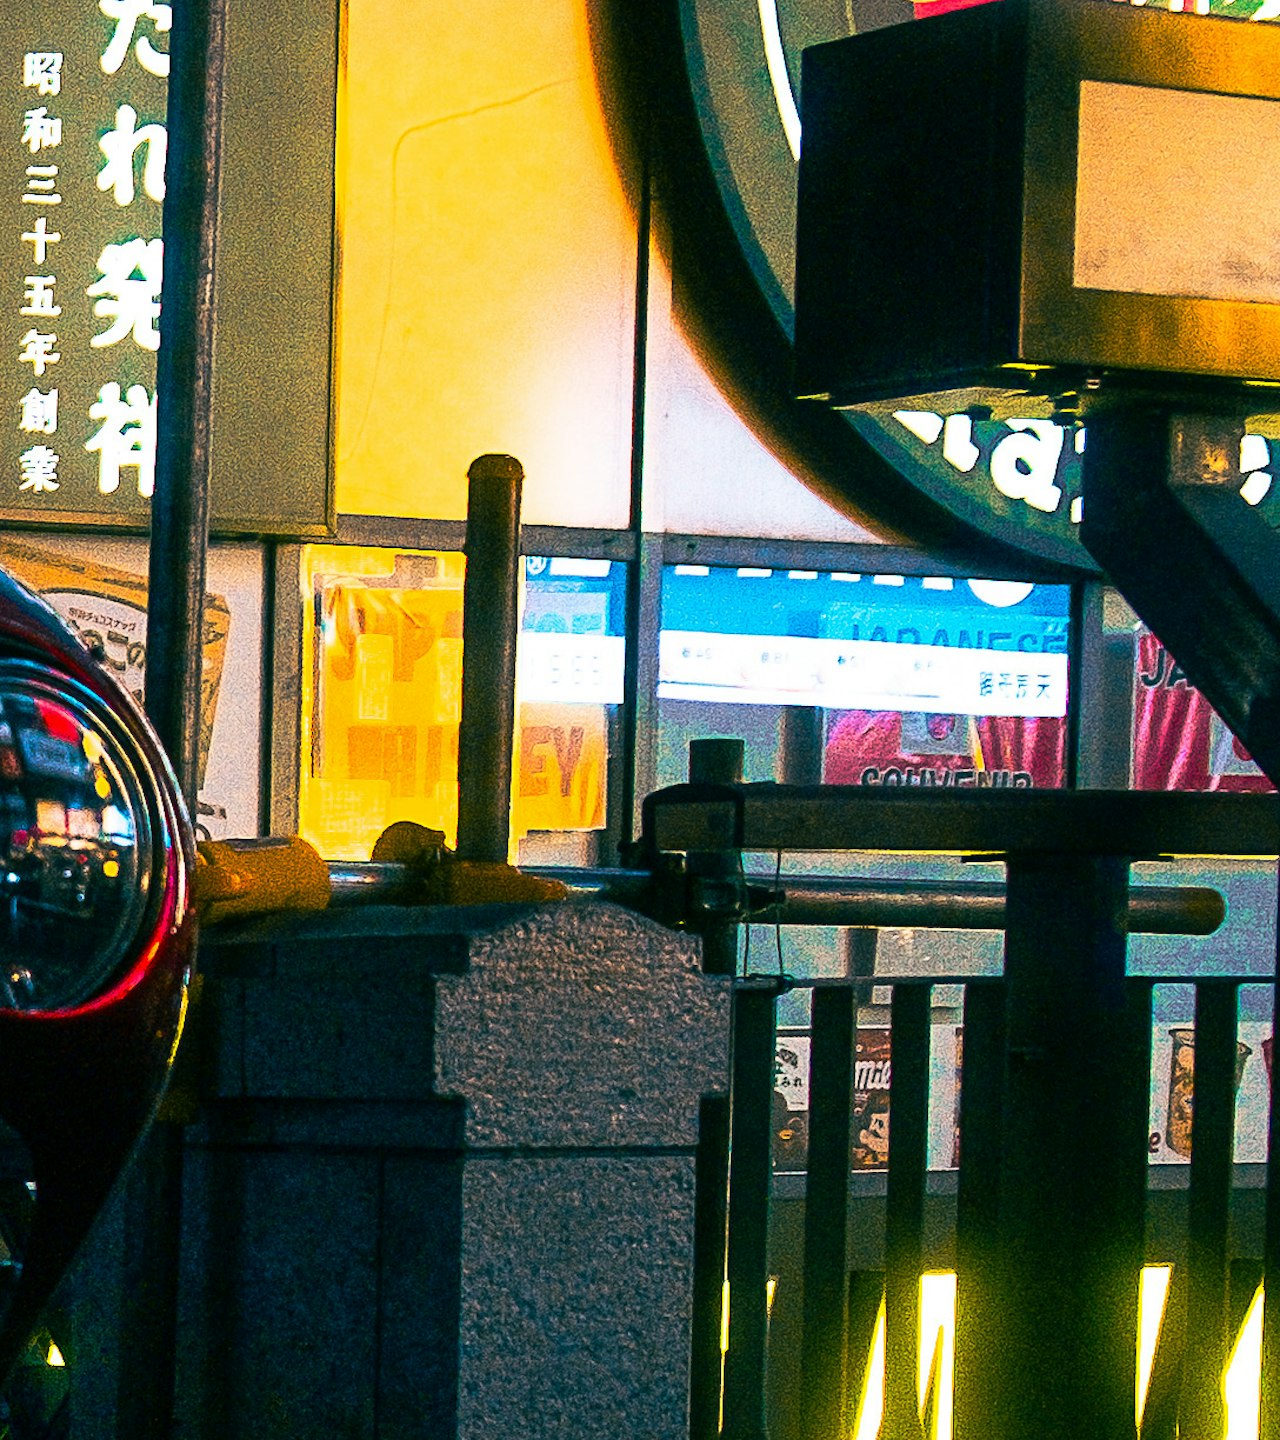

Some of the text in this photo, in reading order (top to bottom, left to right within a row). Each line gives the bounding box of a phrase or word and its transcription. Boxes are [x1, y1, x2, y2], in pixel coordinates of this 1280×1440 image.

[17, 50, 65, 494] 昭和三十五年創業
